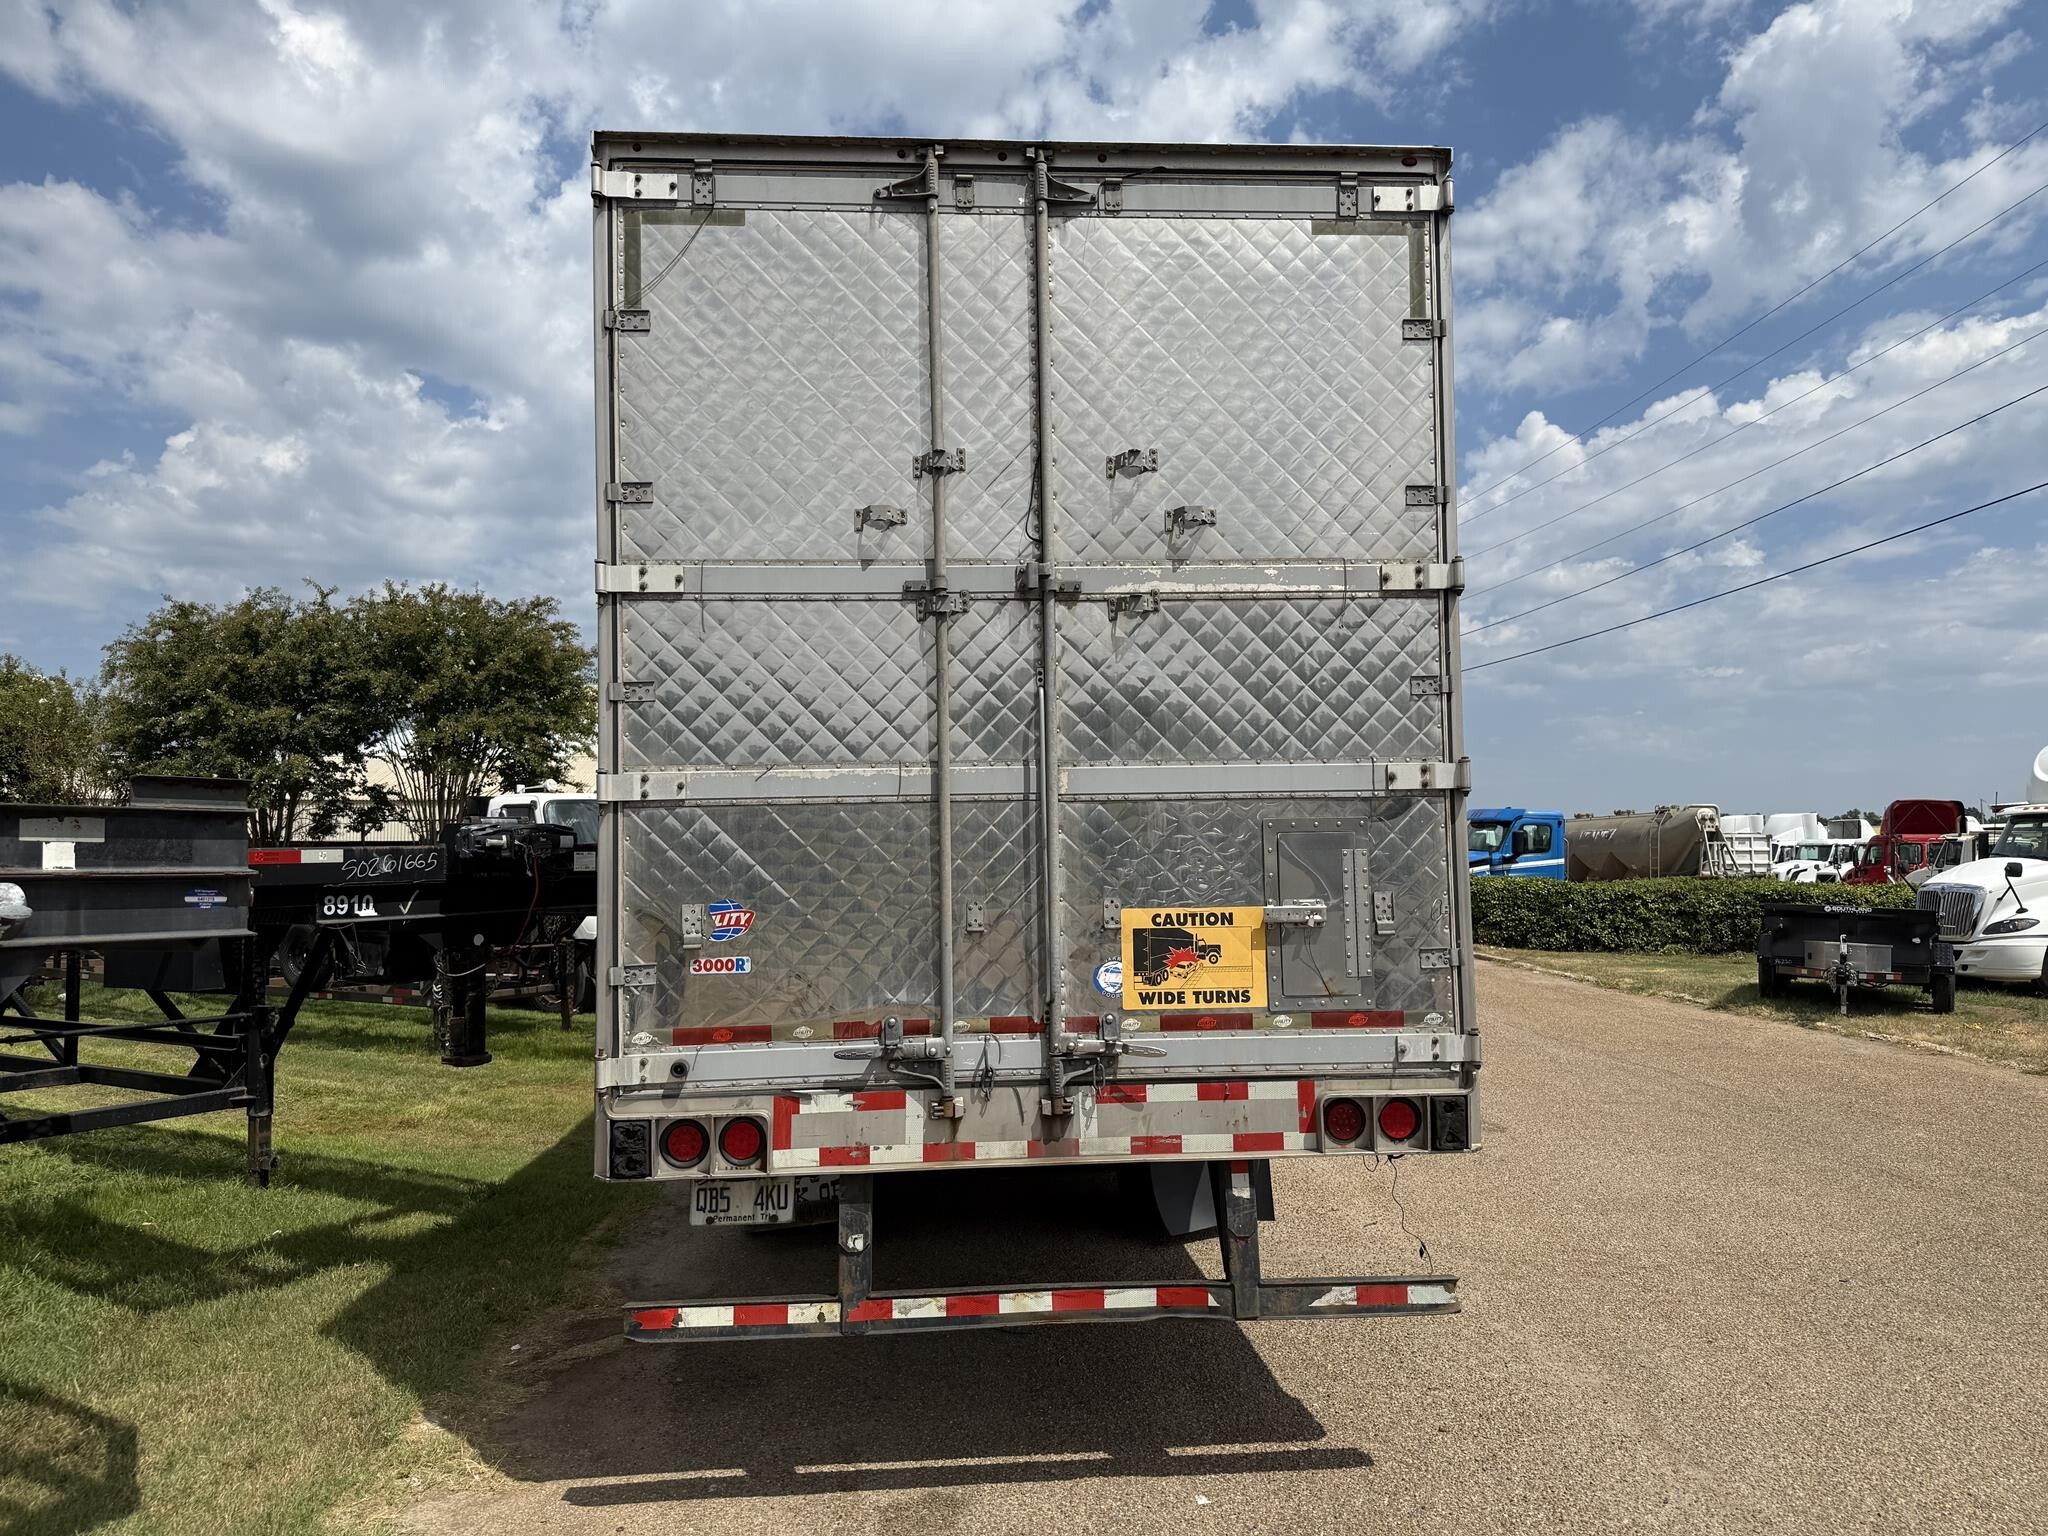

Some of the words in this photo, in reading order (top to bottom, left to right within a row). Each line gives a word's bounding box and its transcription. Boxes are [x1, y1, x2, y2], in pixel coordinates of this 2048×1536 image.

[323, 895, 376, 915] 8910
[1151, 912, 1234, 926] CAUTION
[1138, 991, 1186, 1004] WIDE
[1193, 990, 1251, 1003] TURNS
[713, 1214, 755, 1222] Permanent
